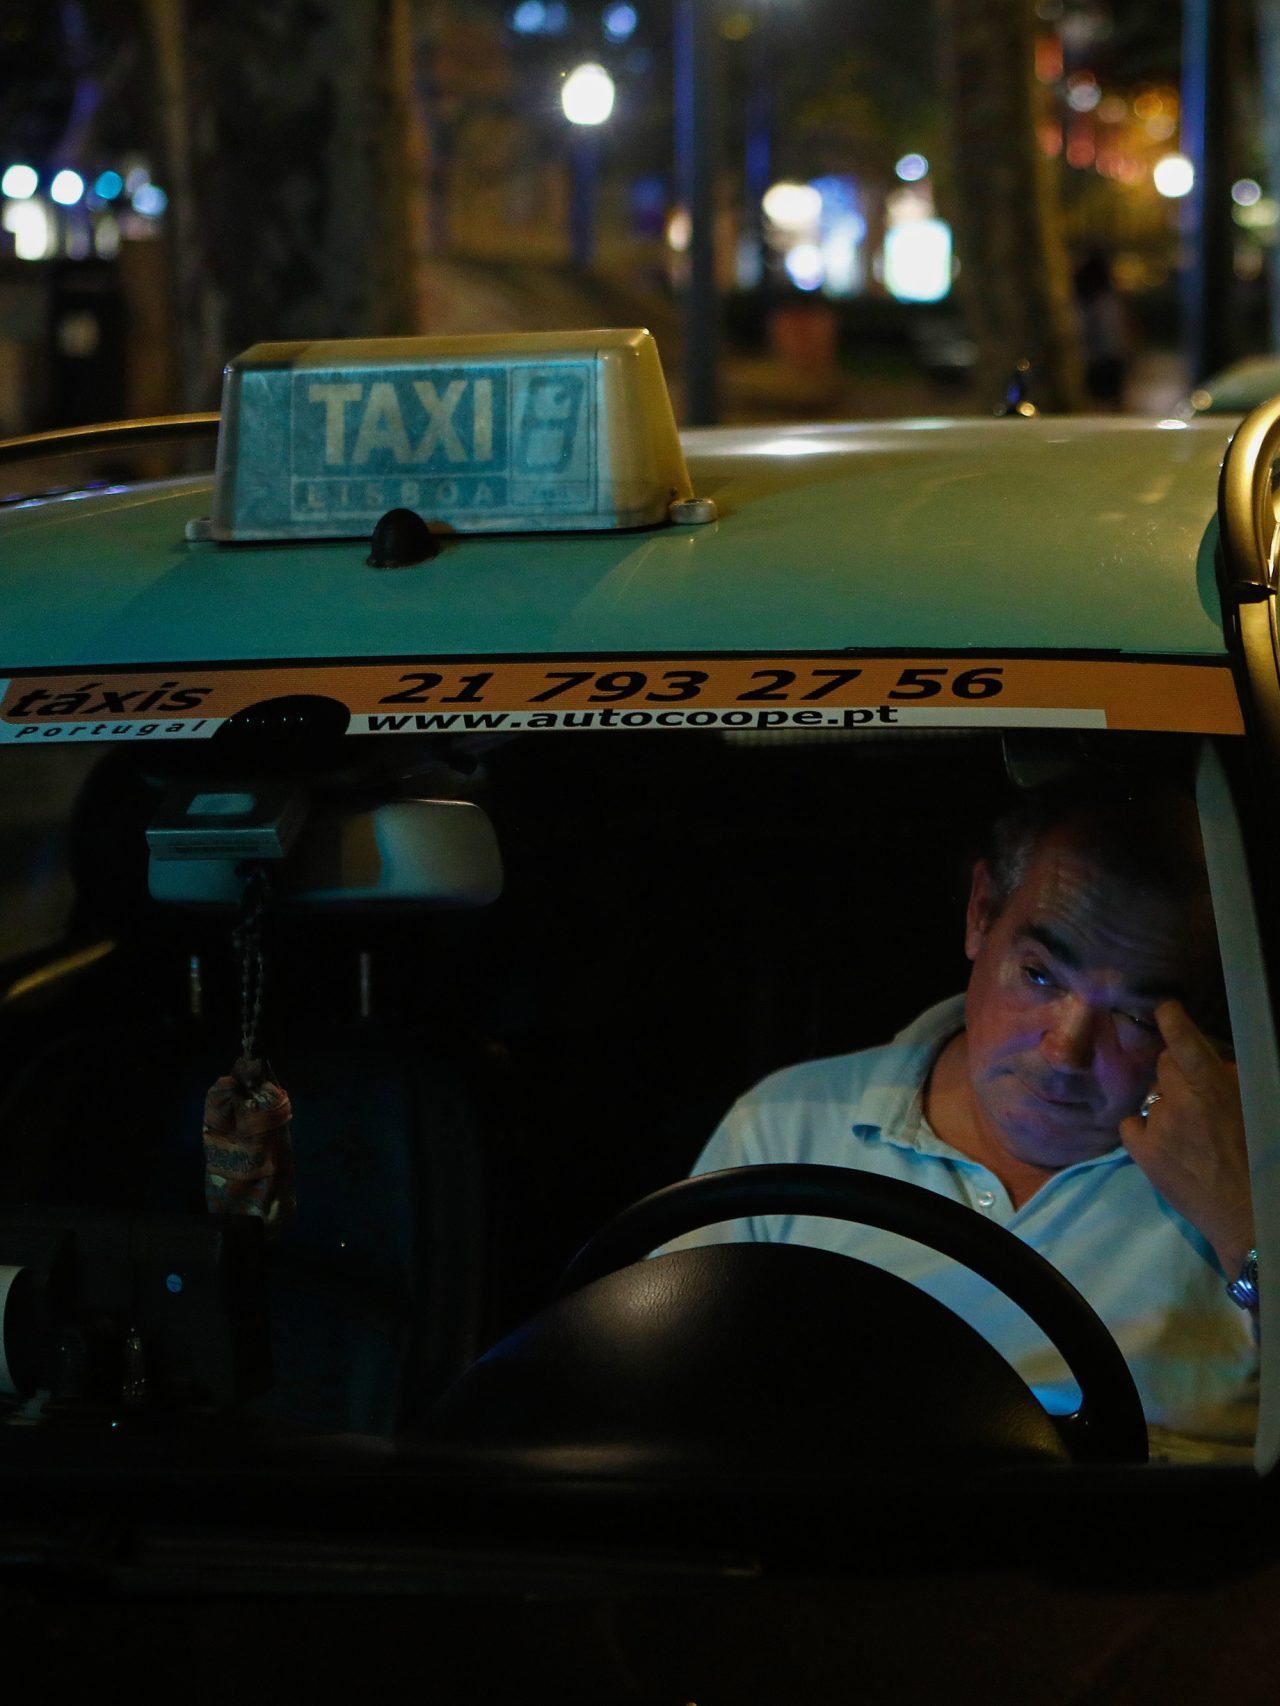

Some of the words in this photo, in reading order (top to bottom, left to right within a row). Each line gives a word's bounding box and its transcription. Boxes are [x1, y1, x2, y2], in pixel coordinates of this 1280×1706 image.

[308, 379, 494, 465] TAXI
[306, 480, 497, 508] LISBOA
[7, 682, 214, 717] táxis
[378, 672, 493, 703] 21
[527, 671, 709, 702] 793
[736, 669, 862, 701] 27
[888, 668, 1005, 700] 56
[367, 705, 899, 730] www.autocoope.pt
